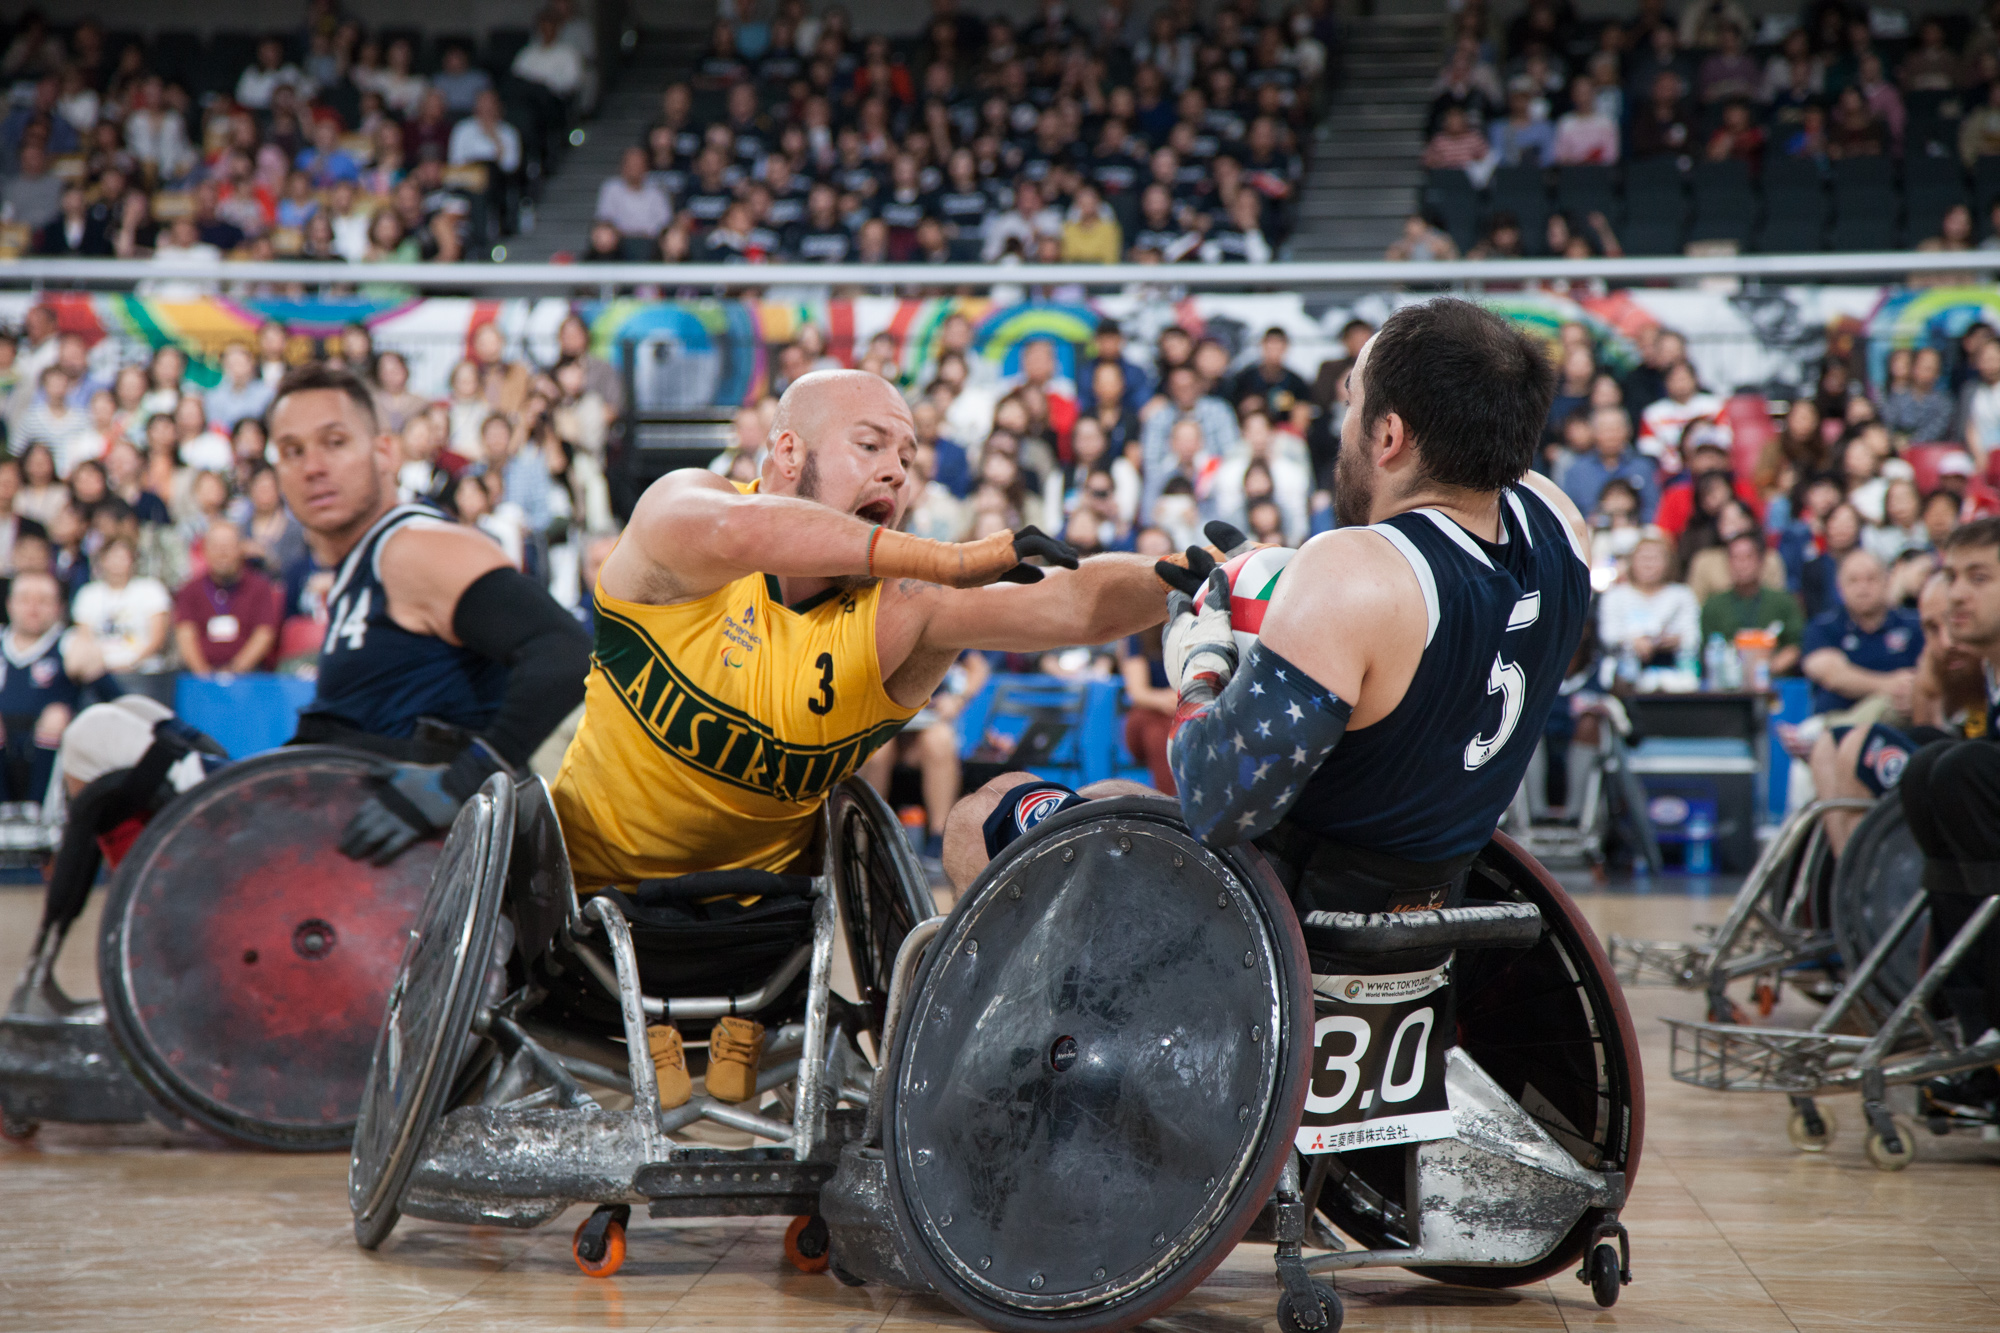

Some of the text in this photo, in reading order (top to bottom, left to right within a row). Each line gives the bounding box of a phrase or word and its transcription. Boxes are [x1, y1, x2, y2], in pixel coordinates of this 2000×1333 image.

[324, 587, 372, 655] 14
[808, 652, 834, 716] 3
[1367, 982, 1395, 991] WWRC
[1397, 979, 1419, 989] TOKYO
[1304, 1006, 1434, 1114] 3.0
[1328, 1124, 1410, 1148] 三菱商事株式会社
